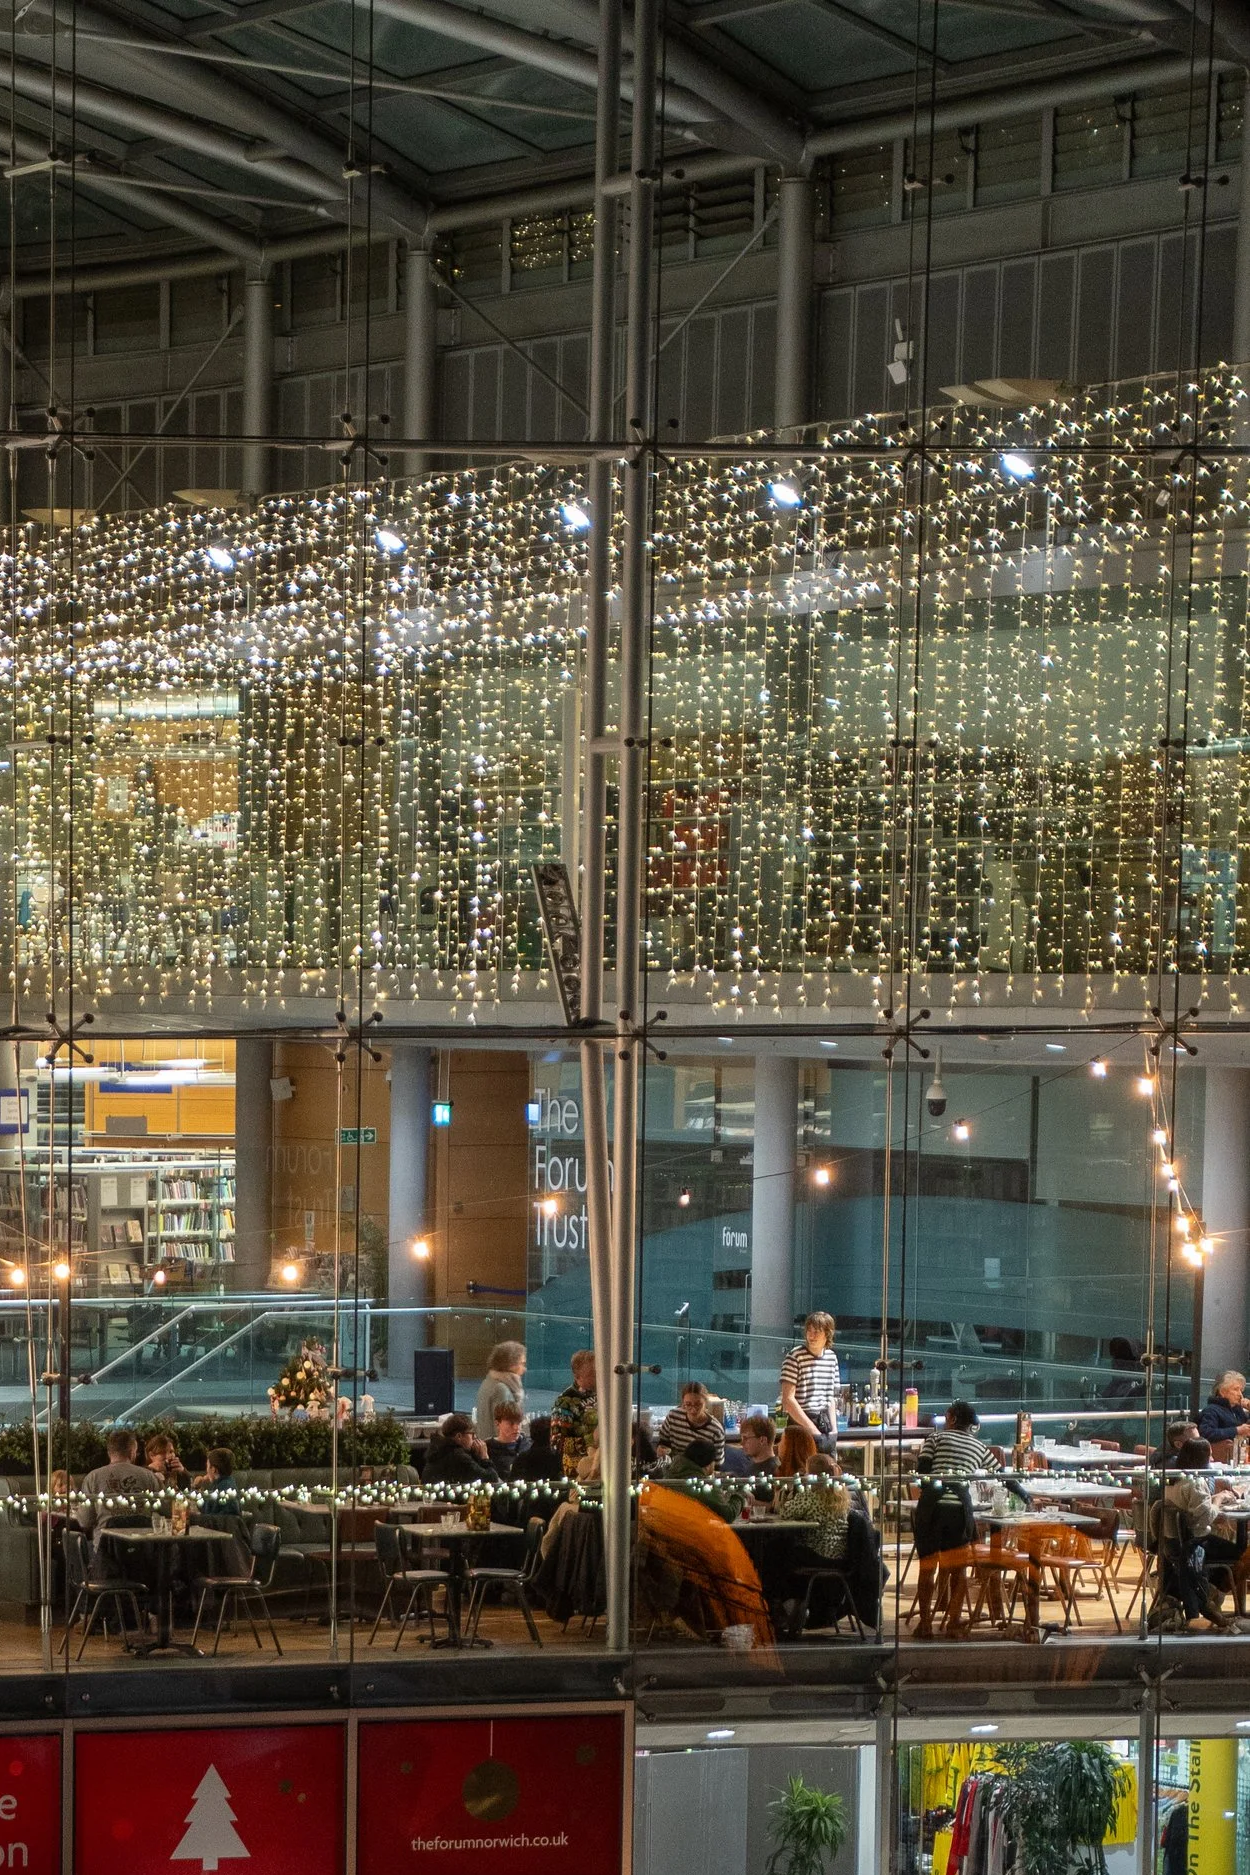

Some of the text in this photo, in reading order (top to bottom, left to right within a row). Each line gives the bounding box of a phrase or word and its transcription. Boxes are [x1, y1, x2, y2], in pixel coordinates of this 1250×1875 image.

[534, 1087, 579, 1134] The
[534, 1145, 614, 1192] Foru
[410, 1831, 569, 1851] theforumnorwich.co.uk
[1188, 1802, 1200, 1840] The
